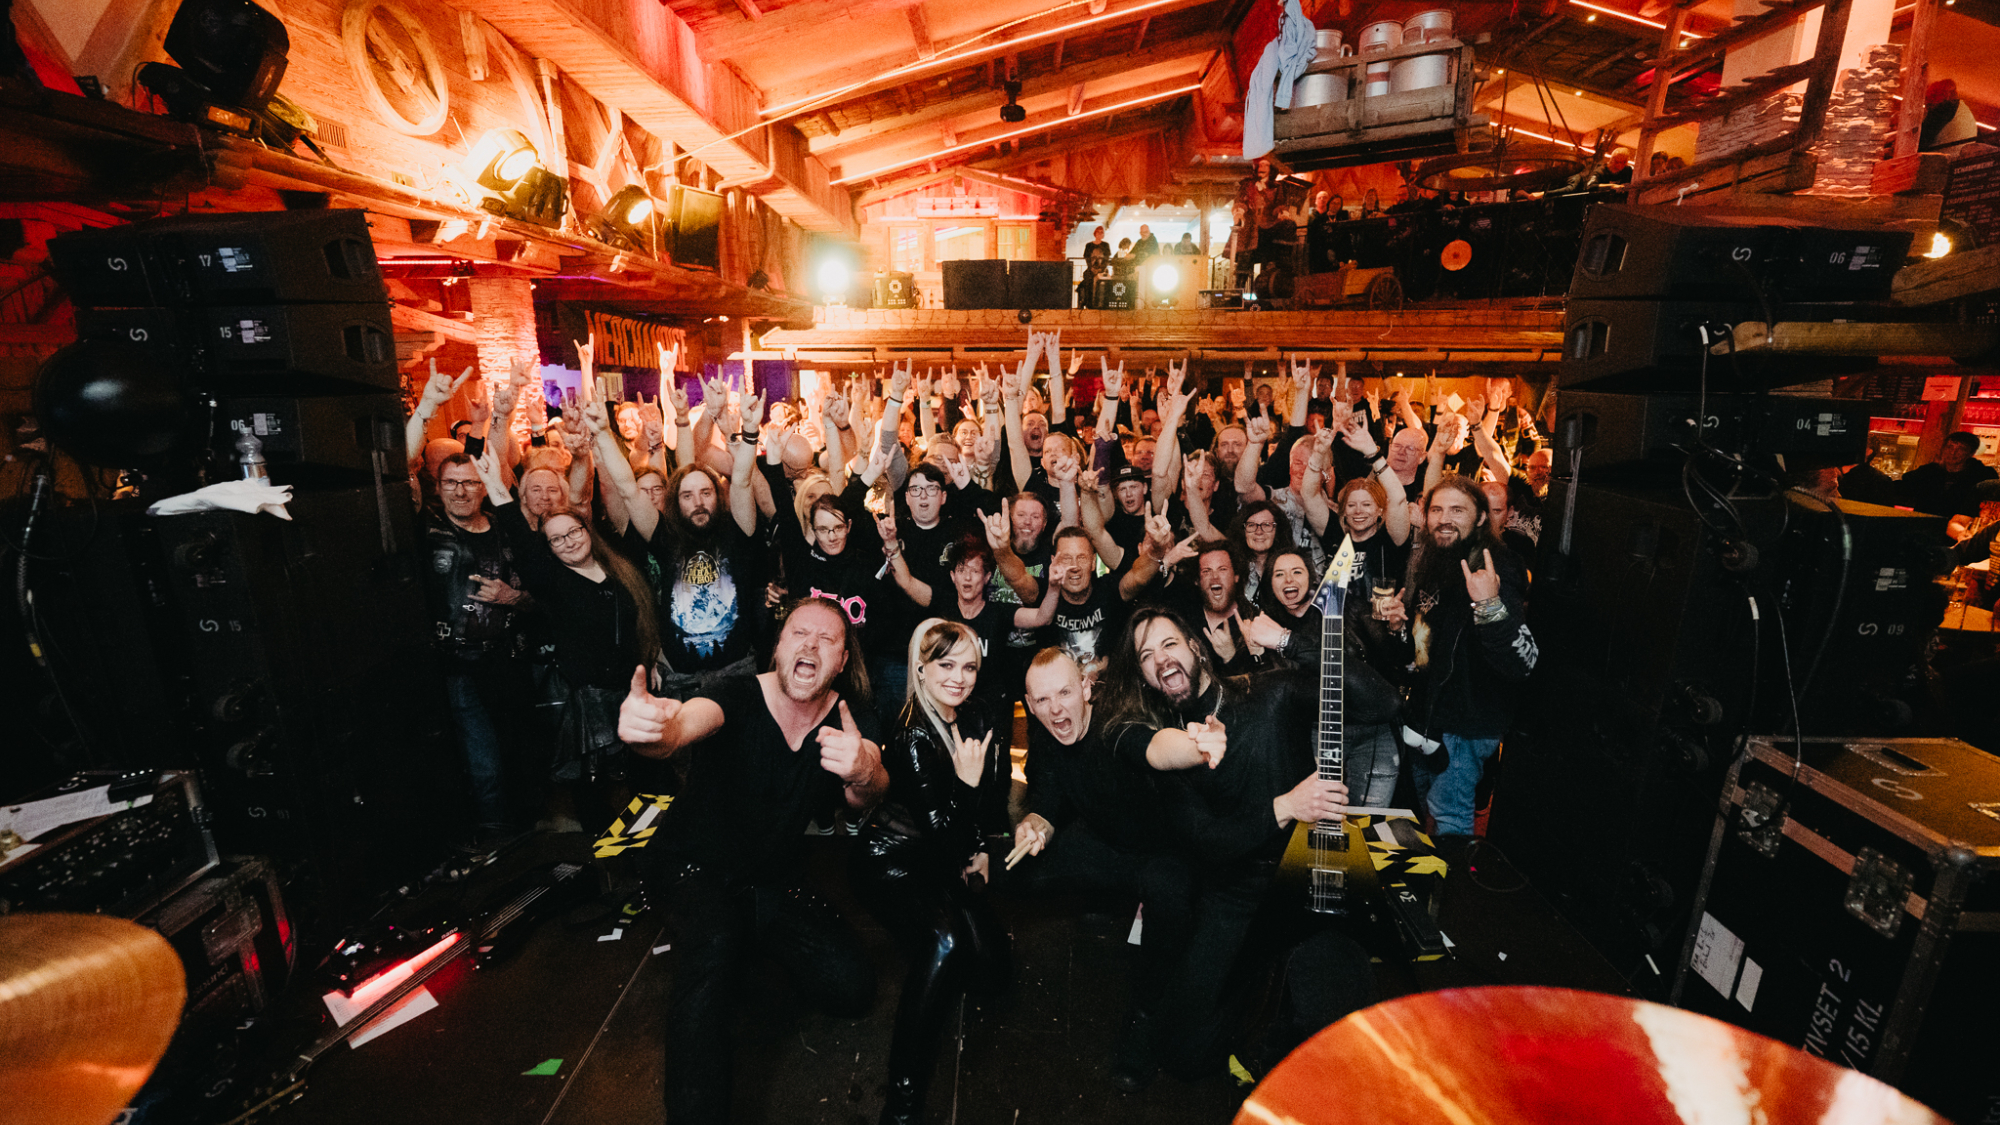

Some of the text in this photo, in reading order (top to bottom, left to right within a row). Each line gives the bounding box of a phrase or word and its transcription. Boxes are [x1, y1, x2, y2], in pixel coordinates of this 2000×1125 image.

[199, 254, 211, 267] 17
[1829, 252, 1846, 264] 06
[220, 326, 232, 339] 15
[231, 419, 245, 430] 06
[1796, 418, 1811, 430] 04
[228, 620, 242, 632] 15
[1887, 623, 1905, 635] 09
[440, 926, 459, 940] nano
[1829, 958, 1851, 982] 2
[1853, 998, 1884, 1032] KL
